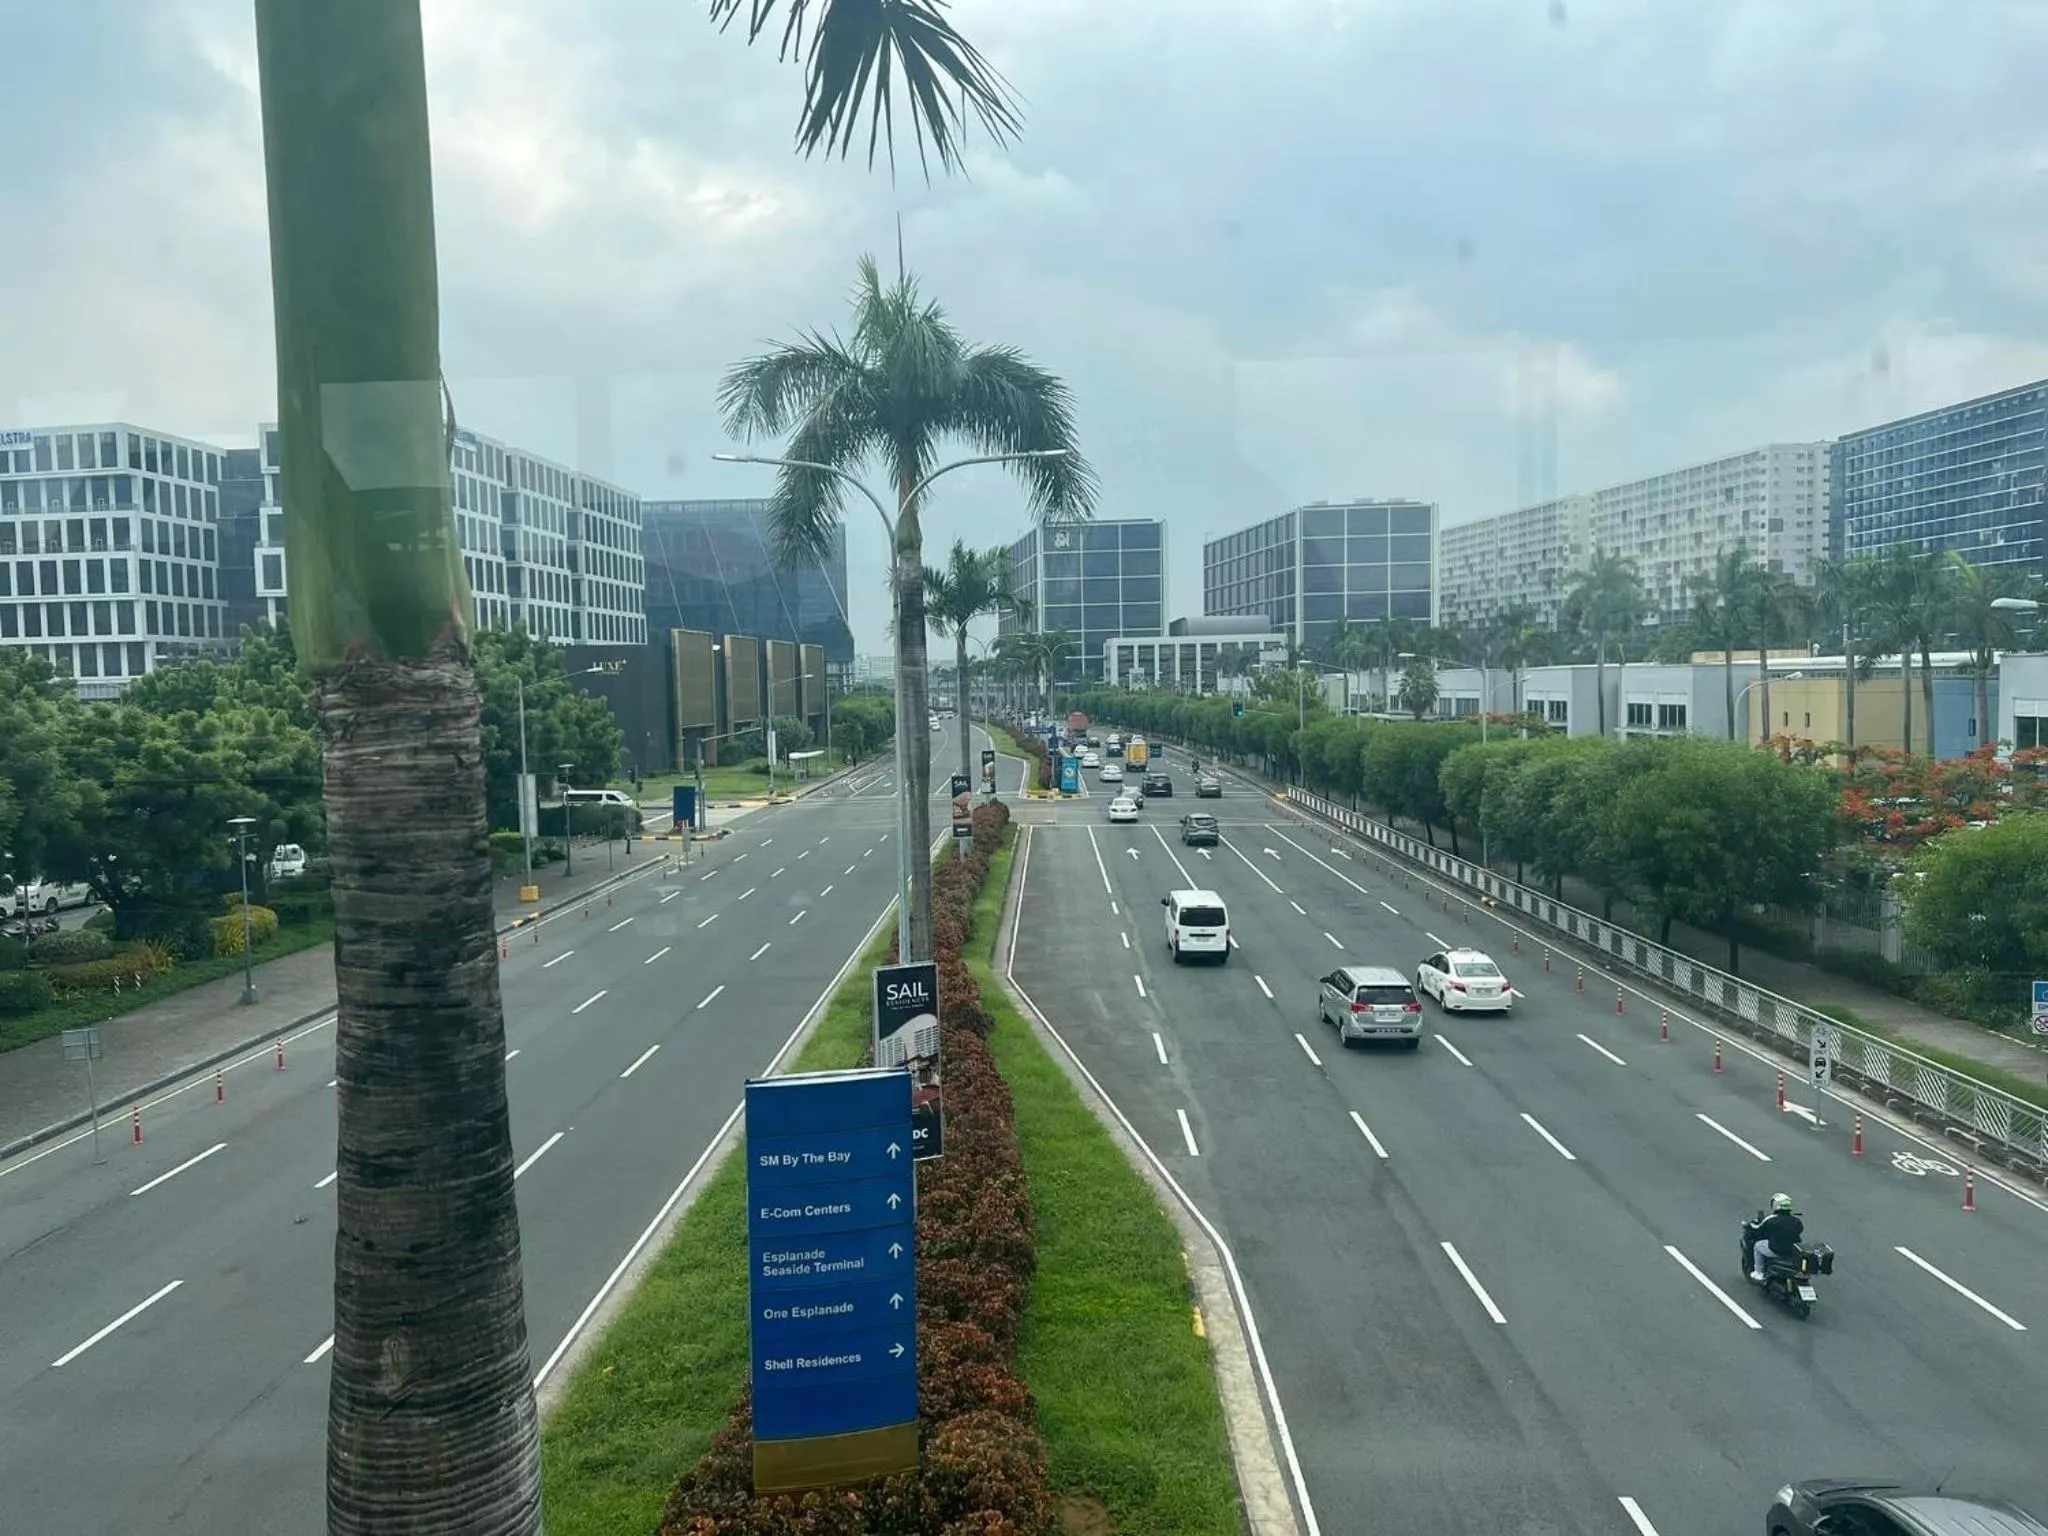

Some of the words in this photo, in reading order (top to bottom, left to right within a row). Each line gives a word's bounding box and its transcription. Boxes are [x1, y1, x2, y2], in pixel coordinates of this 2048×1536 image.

[0, 432, 31, 445] LSTRA
[886, 982, 929, 1000] SAIL
[912, 1127, 929, 1140] DC
[760, 1155, 779, 1167] SM
[782, 1154, 799, 1168] By
[801, 1152, 825, 1164] The
[828, 1151, 851, 1163] Bay
[760, 1207, 802, 1219] E-Com
[804, 1203, 851, 1216] Centers
[762, 1249, 826, 1263] Esplanade
[763, 1264, 811, 1277] Seaside
[814, 1257, 864, 1272] Terminal
[763, 1308, 789, 1320] One
[791, 1302, 854, 1318] Esplanade
[764, 1359, 794, 1371] Shell
[796, 1353, 862, 1369] Residences
